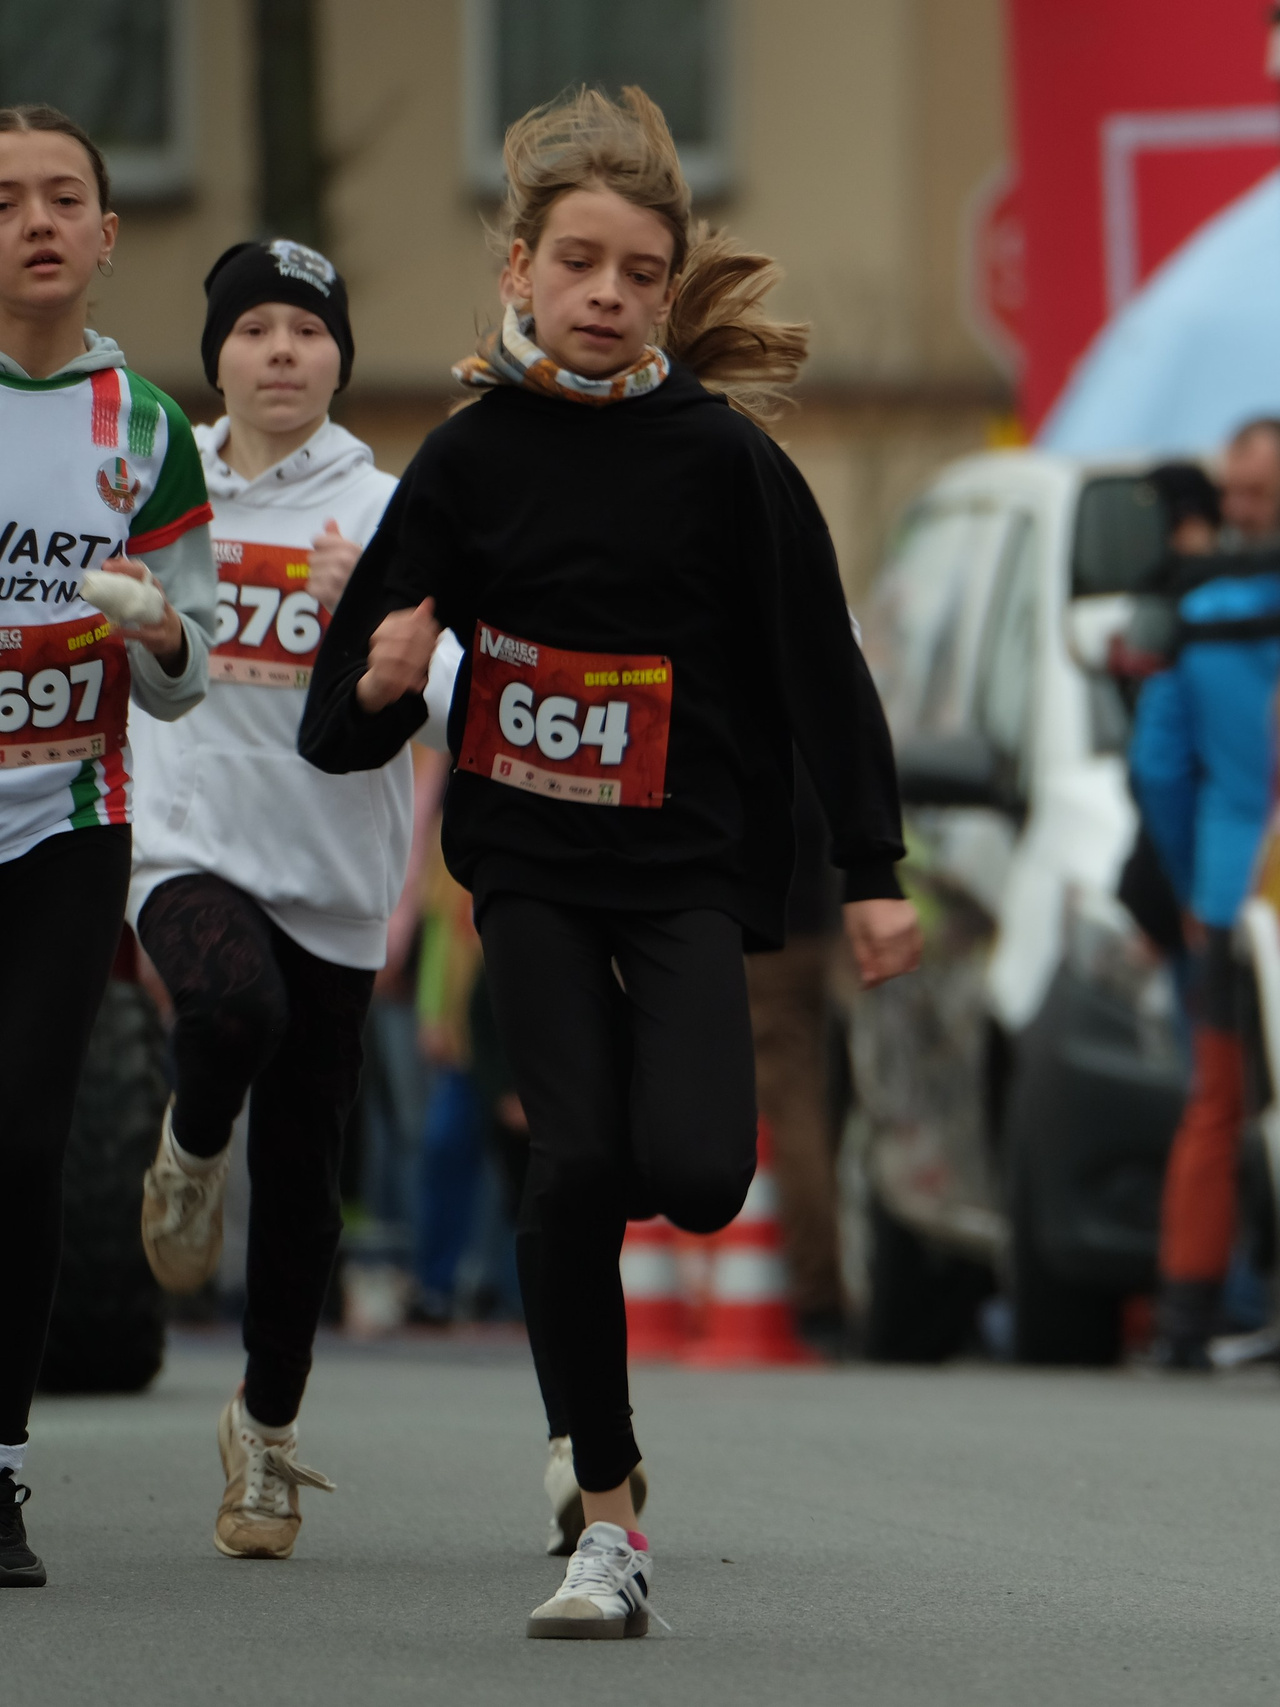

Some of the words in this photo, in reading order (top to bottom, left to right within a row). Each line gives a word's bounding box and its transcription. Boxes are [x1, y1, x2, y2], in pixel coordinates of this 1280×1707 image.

[0, 521, 123, 569] ARTA
[0, 571, 86, 604] UŻYN
[286, 563, 311, 579] BIE
[215, 581, 321, 655] 676
[67, 633, 95, 651] BIEG
[94, 622, 112, 638] DZI
[480, 626, 508, 660] IV
[503, 640, 538, 659] BIEG
[584, 671, 620, 687] BIEG
[621, 667, 668, 686] DZIECI
[0, 659, 104, 733] 697
[498, 681, 629, 765] 664
